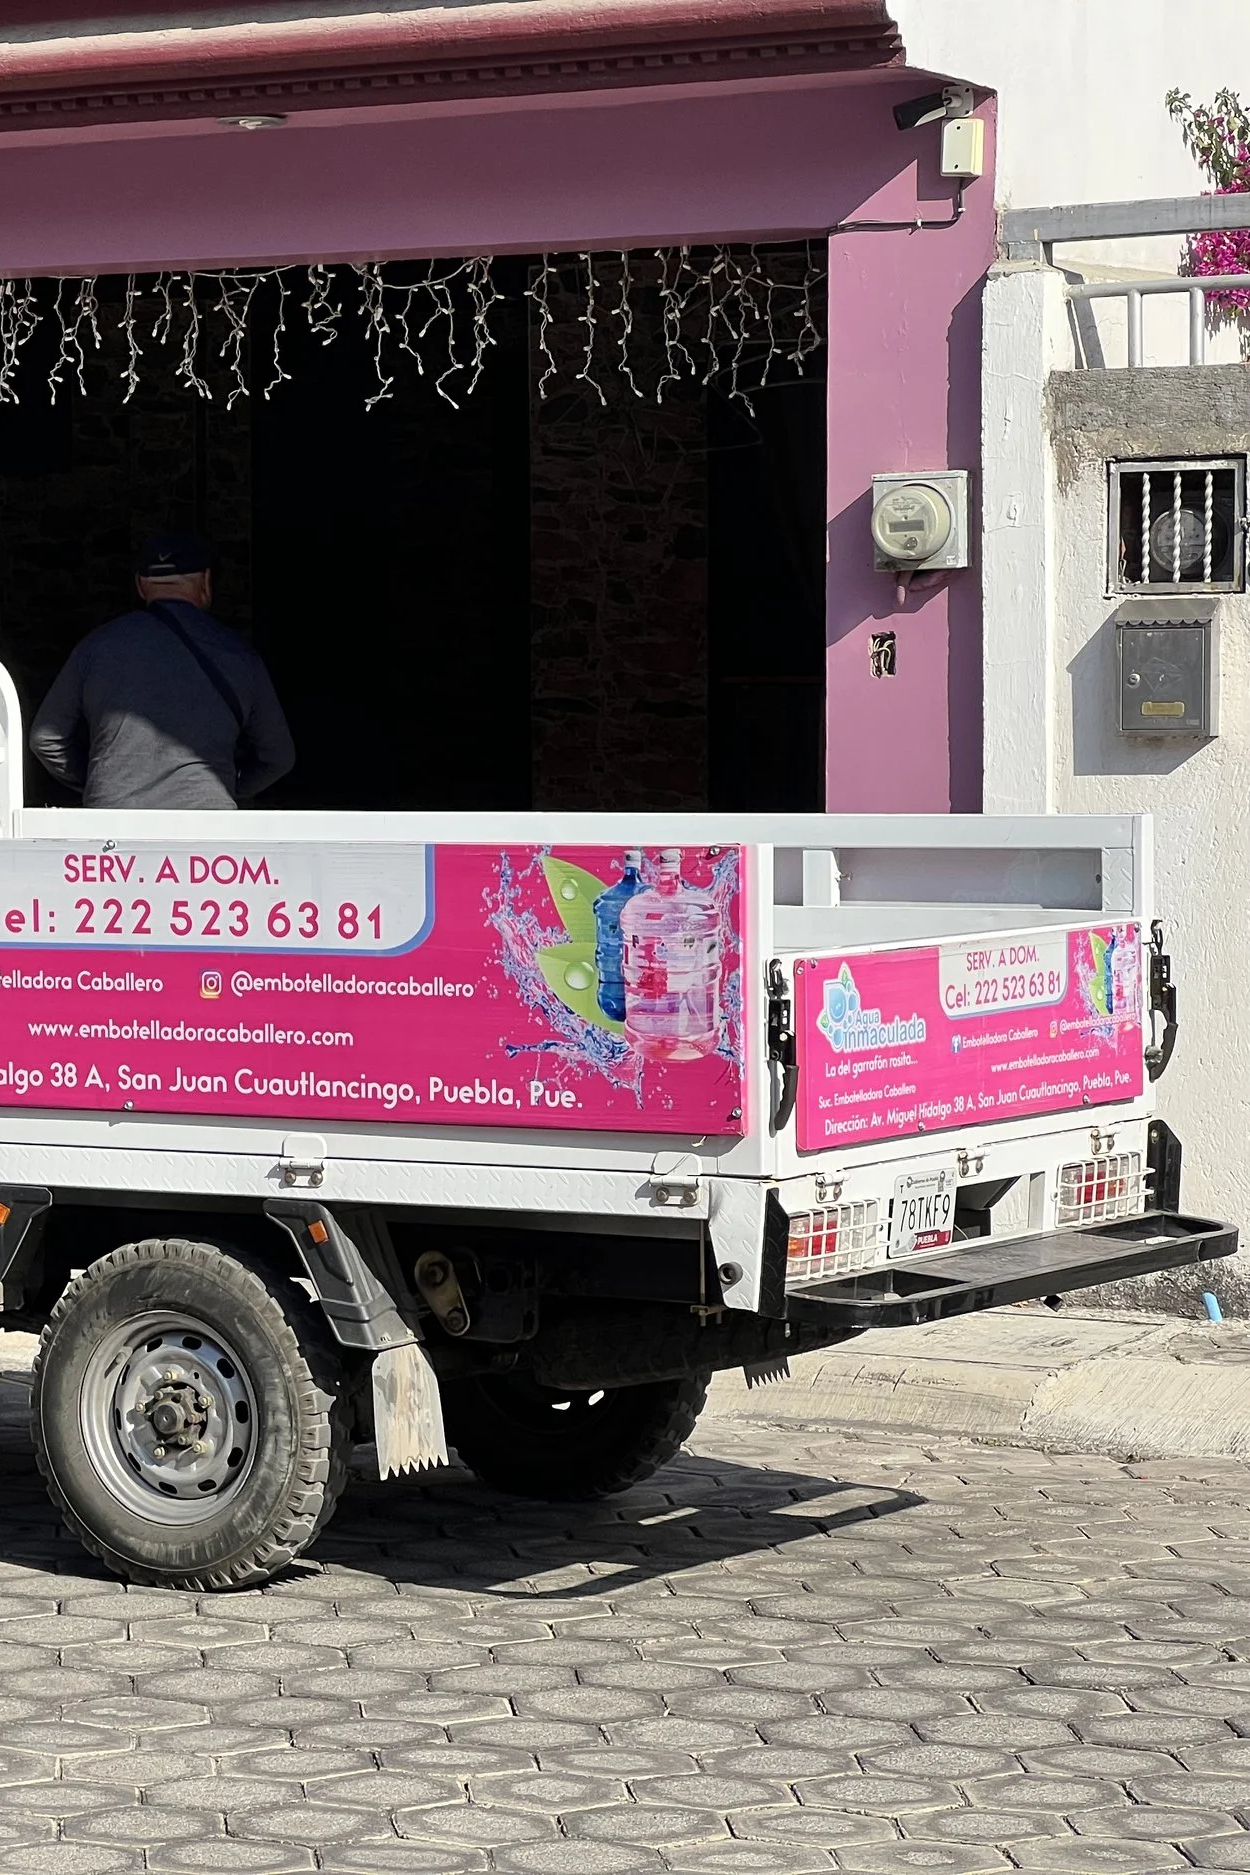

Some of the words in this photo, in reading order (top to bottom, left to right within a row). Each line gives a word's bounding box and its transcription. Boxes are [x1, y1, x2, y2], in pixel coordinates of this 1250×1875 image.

[63, 854, 145, 884] SERV.
[155, 857, 180, 884] A
[190, 854, 279, 885] DOM.
[74, 899, 152, 935] 222
[169, 901, 249, 937] 523
[267, 903, 320, 938] 63
[337, 904, 382, 939] 81
[966, 951, 995, 972] SERV.
[998, 949, 1007, 967] A
[1010, 945, 1040, 965] DOM.
[77, 971, 163, 993] Caballero
[230, 970, 474, 998] @embotelladoracaballero
[945, 984, 970, 1009] Cel:
[975, 978, 998, 1005] 222
[1002, 975, 1025, 1001] 523
[1029, 972, 1044, 997] 63
[1048, 971, 1060, 994] 81
[28, 1018, 354, 1047] www.embotelladoracaballero.com
[855, 1011, 880, 1028] Agua
[963, 1031, 1007, 1048] Embotelladora
[1009, 1027, 1039, 1041] Caballero
[825, 1062, 837, 1077] La
[838, 1059, 851, 1076] del
[852, 1055, 888, 1078] garrafón
[889, 1051, 918, 1067] rosita...
[991, 1048, 1100, 1073] www.embotelladoracaballero.com
[49, 1063, 78, 1089] 38
[84, 1065, 111, 1093] A,
[120, 1065, 161, 1091] San
[168, 1067, 228, 1093] Juan
[234, 1069, 421, 1110] Cuautlancingo,
[428, 1078, 521, 1107] Puebla,
[529, 1081, 582, 1108] Pue.
[818, 1096, 833, 1109] Suc.
[834, 1089, 883, 1106] Embotelladora
[884, 1083, 916, 1098] Caballero
[825, 1115, 868, 1136] Dirección:
[871, 1112, 884, 1127] Av.
[887, 1104, 917, 1128] Miguel
[918, 1099, 952, 1120] Hidalgo
[954, 1096, 964, 1113] 38
[966, 1095, 976, 1112] A,
[978, 1092, 994, 1109] San
[997, 1089, 1017, 1105] Juan
[1019, 1079, 1081, 1101] Cuautlancingo,
[1083, 1072, 1113, 1090] Puebla,
[1115, 1070, 1132, 1085] Pue.
[901, 1194, 950, 1232] 78TKF9
[917, 1233, 939, 1246] PUEBLA
